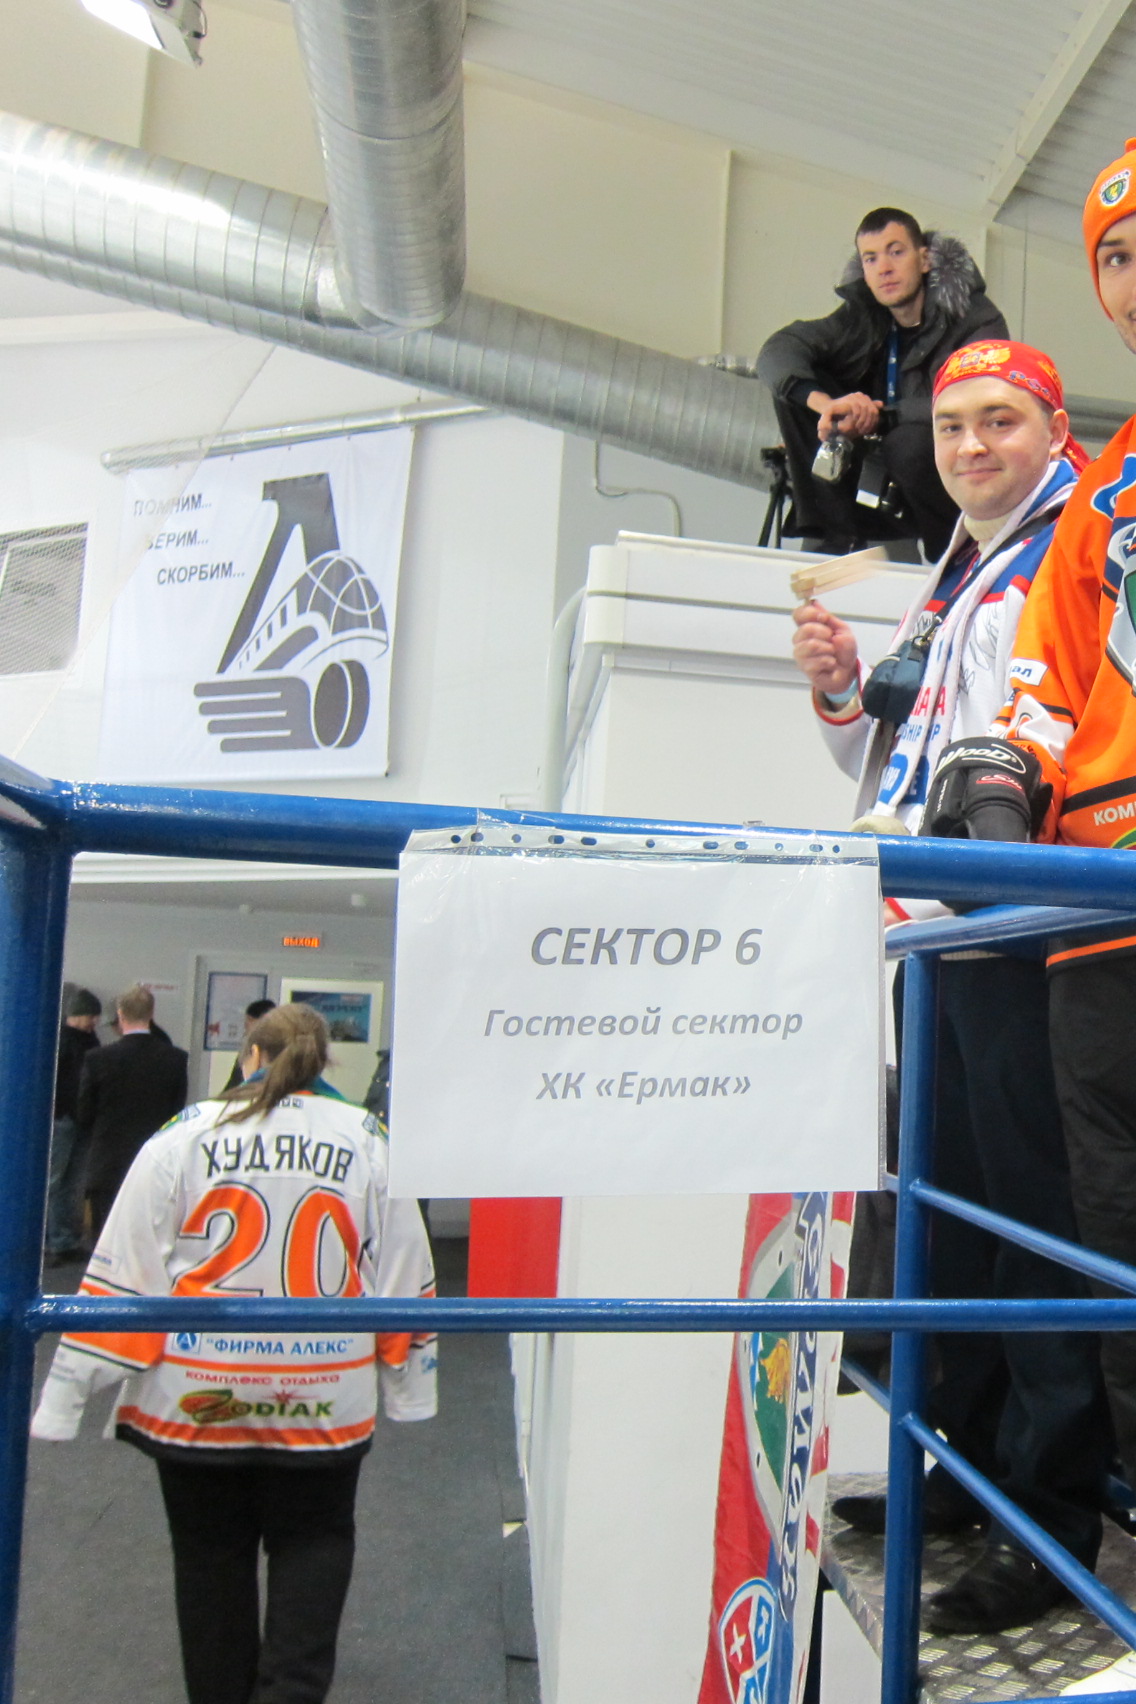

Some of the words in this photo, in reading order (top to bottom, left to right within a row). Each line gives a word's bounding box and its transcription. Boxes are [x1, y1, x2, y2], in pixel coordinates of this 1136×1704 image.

[530, 927, 722, 966] СЕКТОР
[735, 928, 764, 966] 6
[483, 1006, 662, 1037] Гостевой
[671, 1010, 804, 1040] сектор
[535, 1072, 584, 1100] ХК
[595, 1071, 752, 1105] «Ермак»
[201, 1133, 355, 1183] ХУДЯКОВ
[171, 1181, 368, 1297] 20
[206, 1338, 285, 1355] "ФИРМА
[290, 1338, 354, 1355] АЛЕКС"
